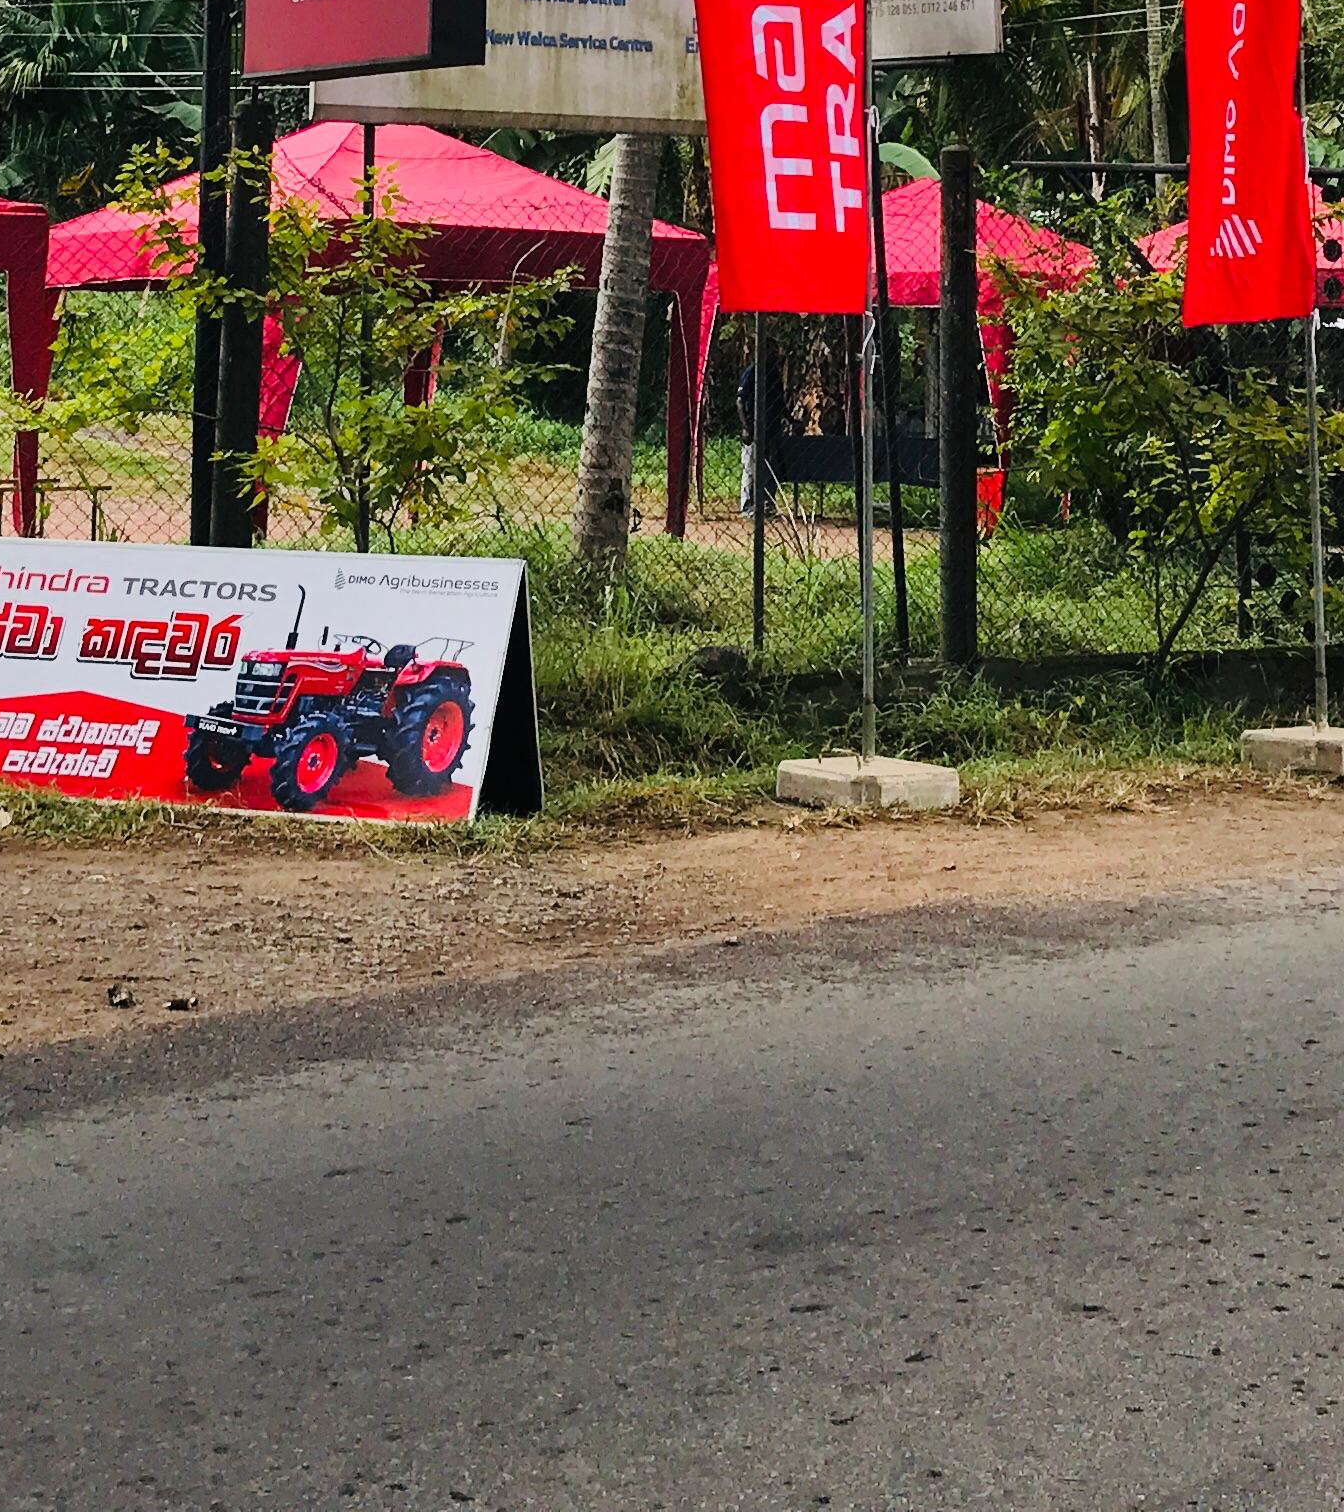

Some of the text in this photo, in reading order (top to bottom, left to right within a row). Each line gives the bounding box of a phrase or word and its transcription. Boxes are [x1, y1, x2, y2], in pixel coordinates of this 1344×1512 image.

[485, 29, 515, 46] New
[559, 32, 607, 50] Service
[123, 577, 278, 602] TRACTORS
[347, 574, 500, 592] DIMO Agribusinesses
